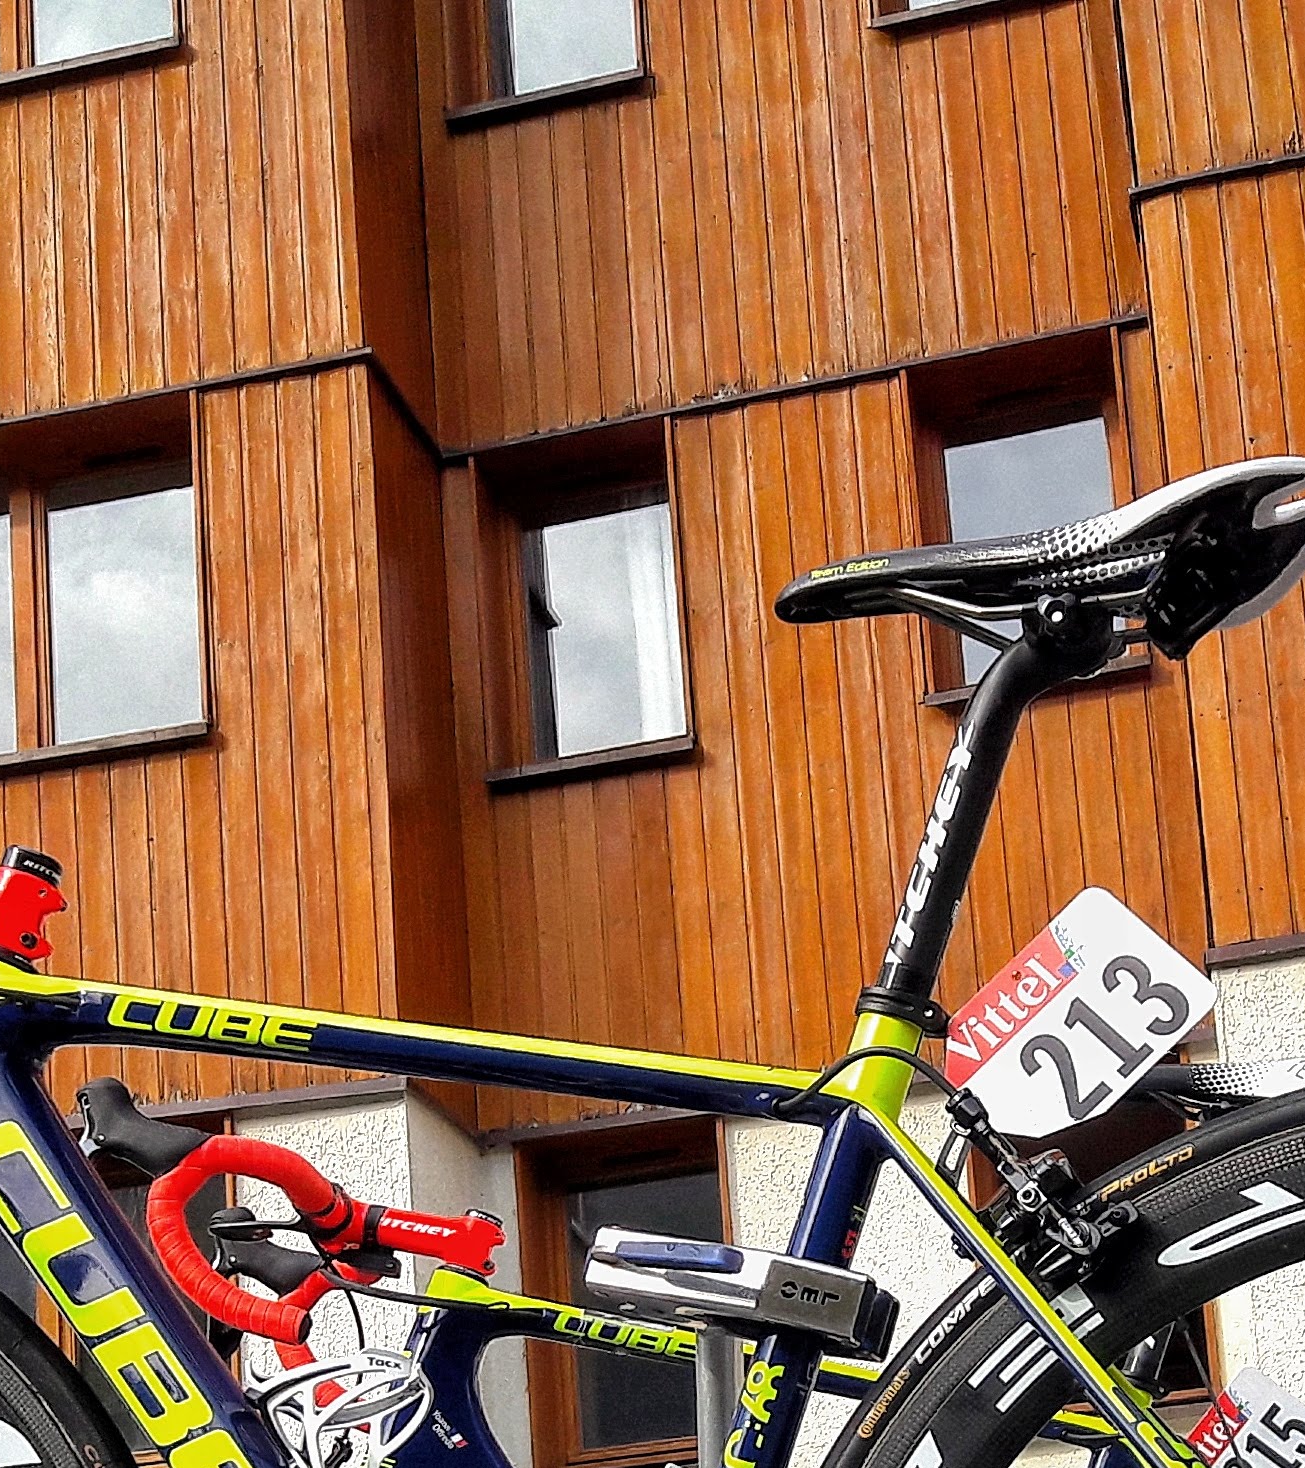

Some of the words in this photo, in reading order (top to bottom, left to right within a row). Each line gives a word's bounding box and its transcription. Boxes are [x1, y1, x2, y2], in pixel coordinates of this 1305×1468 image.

[106, 994, 318, 1052] CUBE
[946, 955, 1063, 1065] Vittel
[1020, 954, 1190, 1120] 213
[366, 1355, 403, 1371] Tacx
